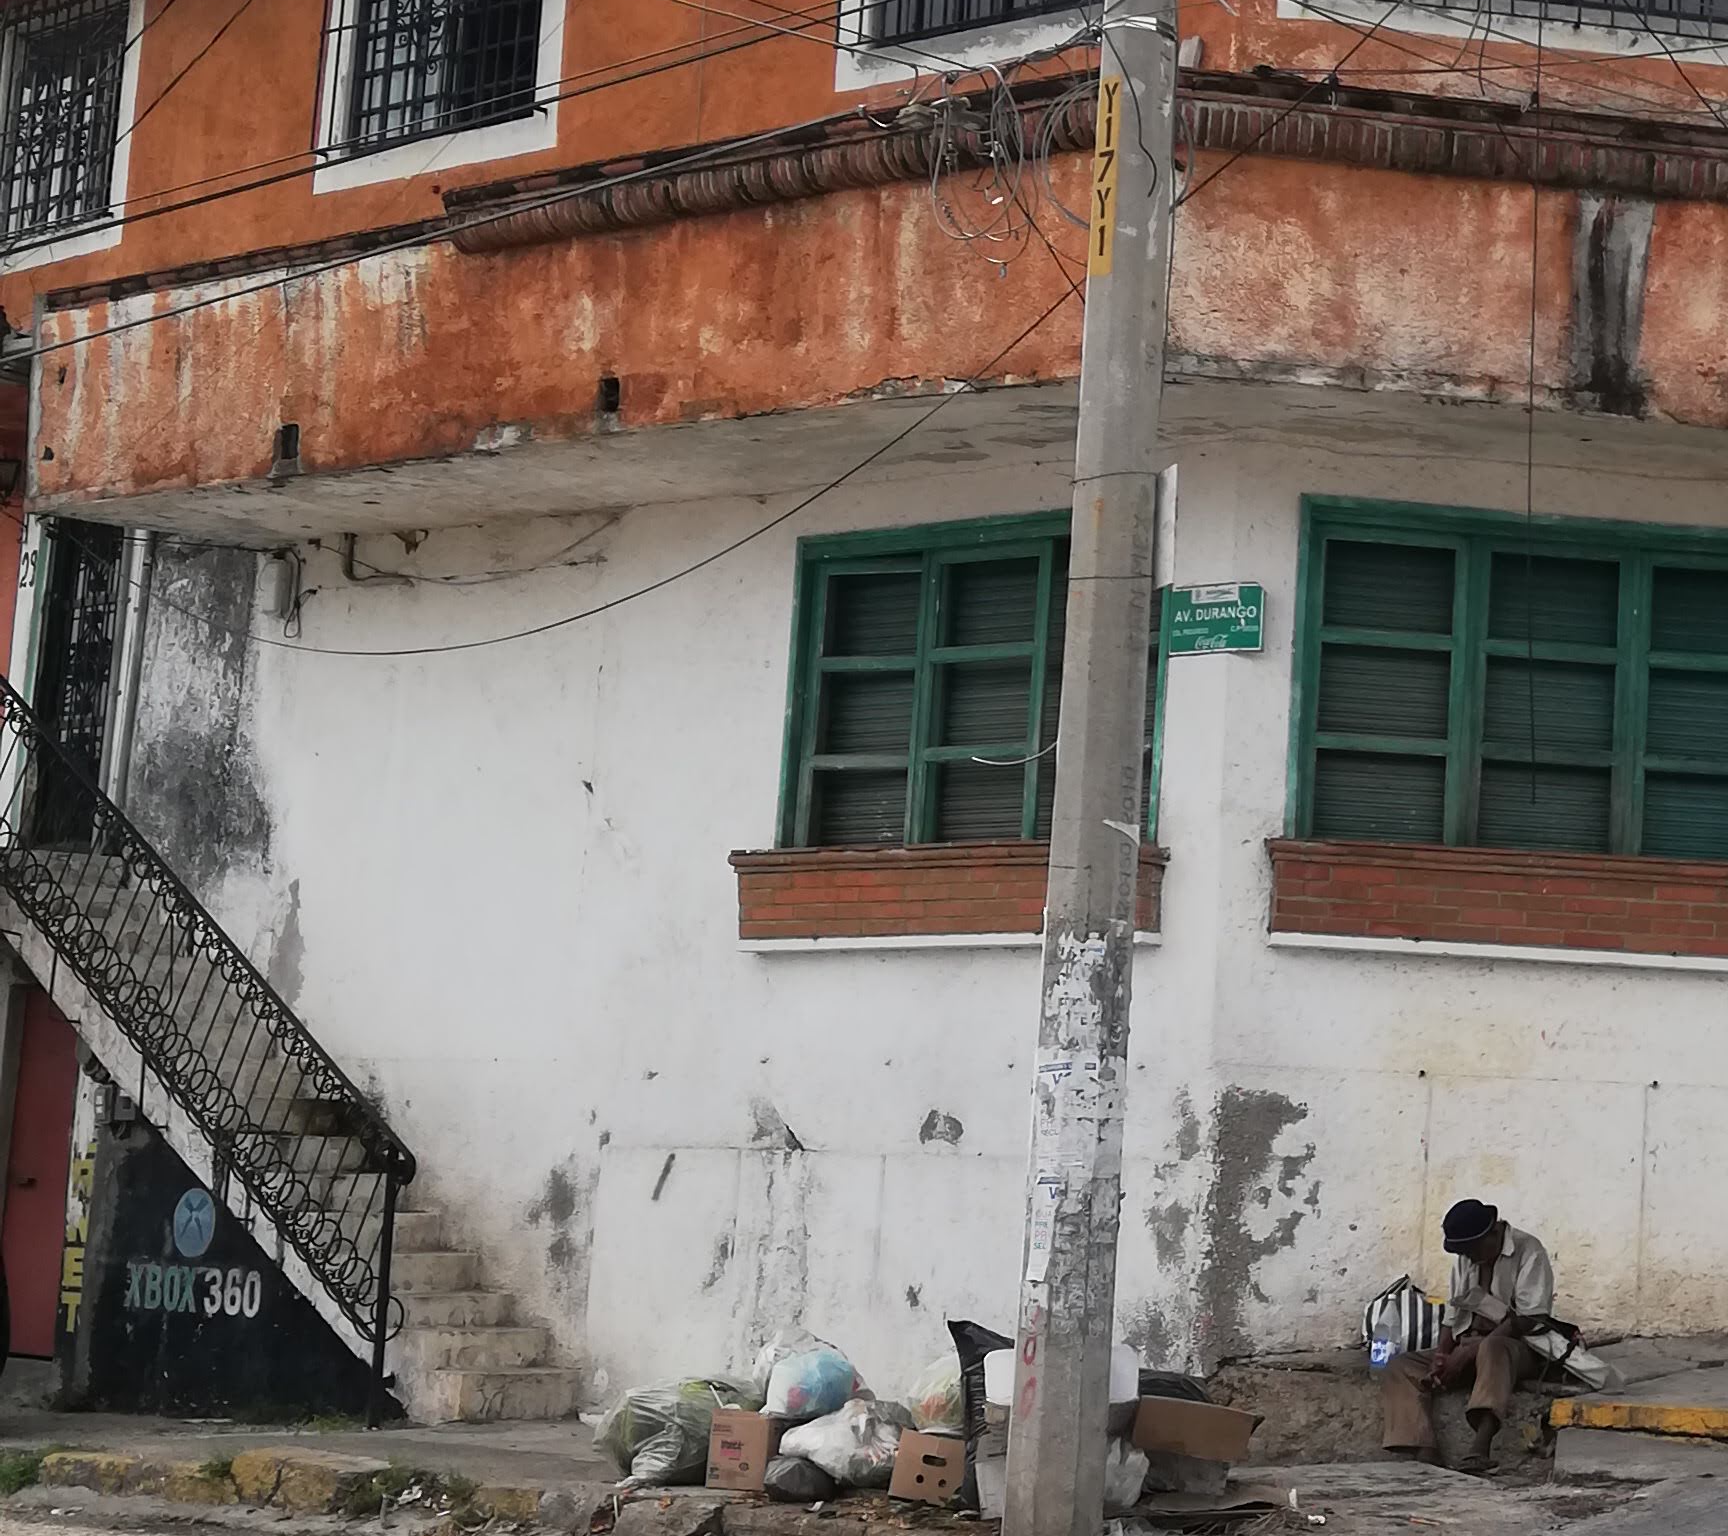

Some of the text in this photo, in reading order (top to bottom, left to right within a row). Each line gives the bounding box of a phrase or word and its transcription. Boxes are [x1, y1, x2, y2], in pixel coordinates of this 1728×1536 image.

[1097, 81, 1119, 256] Y17Y1
[19, 550, 38, 588] 29
[1174, 605, 1257, 623] AV. DURANGO
[124, 1262, 262, 1318] XBOX 360
